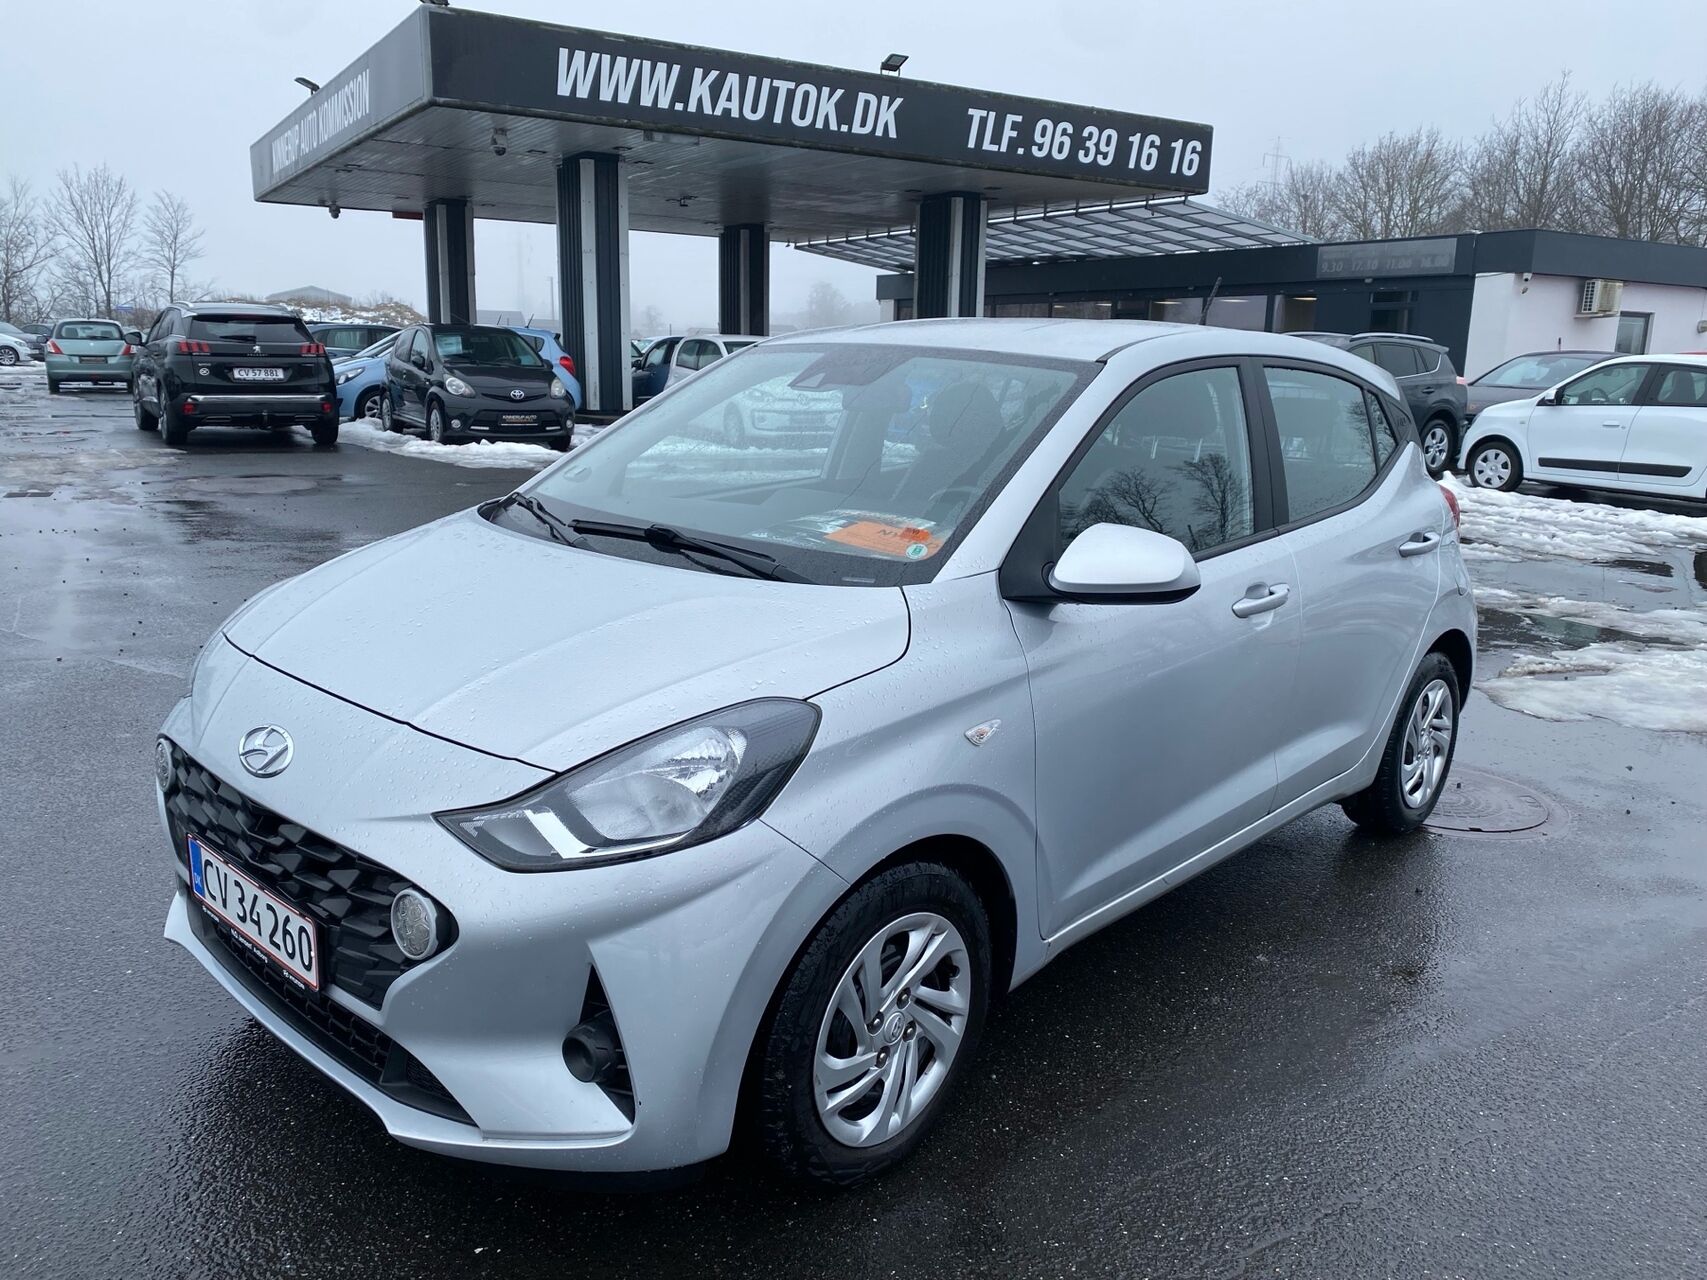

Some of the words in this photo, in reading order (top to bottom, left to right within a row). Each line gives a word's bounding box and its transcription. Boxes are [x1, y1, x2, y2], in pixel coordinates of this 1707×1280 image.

[300, 109, 317, 157] AUTO
[319, 69, 370, 145] KOMMISSION
[556, 47, 904, 139] WWW.KAUTOK.DK
[967, 107, 1024, 155] TLF.
[1031, 118, 1074, 161] 96
[1078, 125, 1119, 167] 39
[1128, 132, 1161, 171] 16
[1169, 138, 1202, 176] 16
[204, 858, 228, 910] CV
[234, 879, 262, 937] 34
[266, 902, 313, 972] 260
